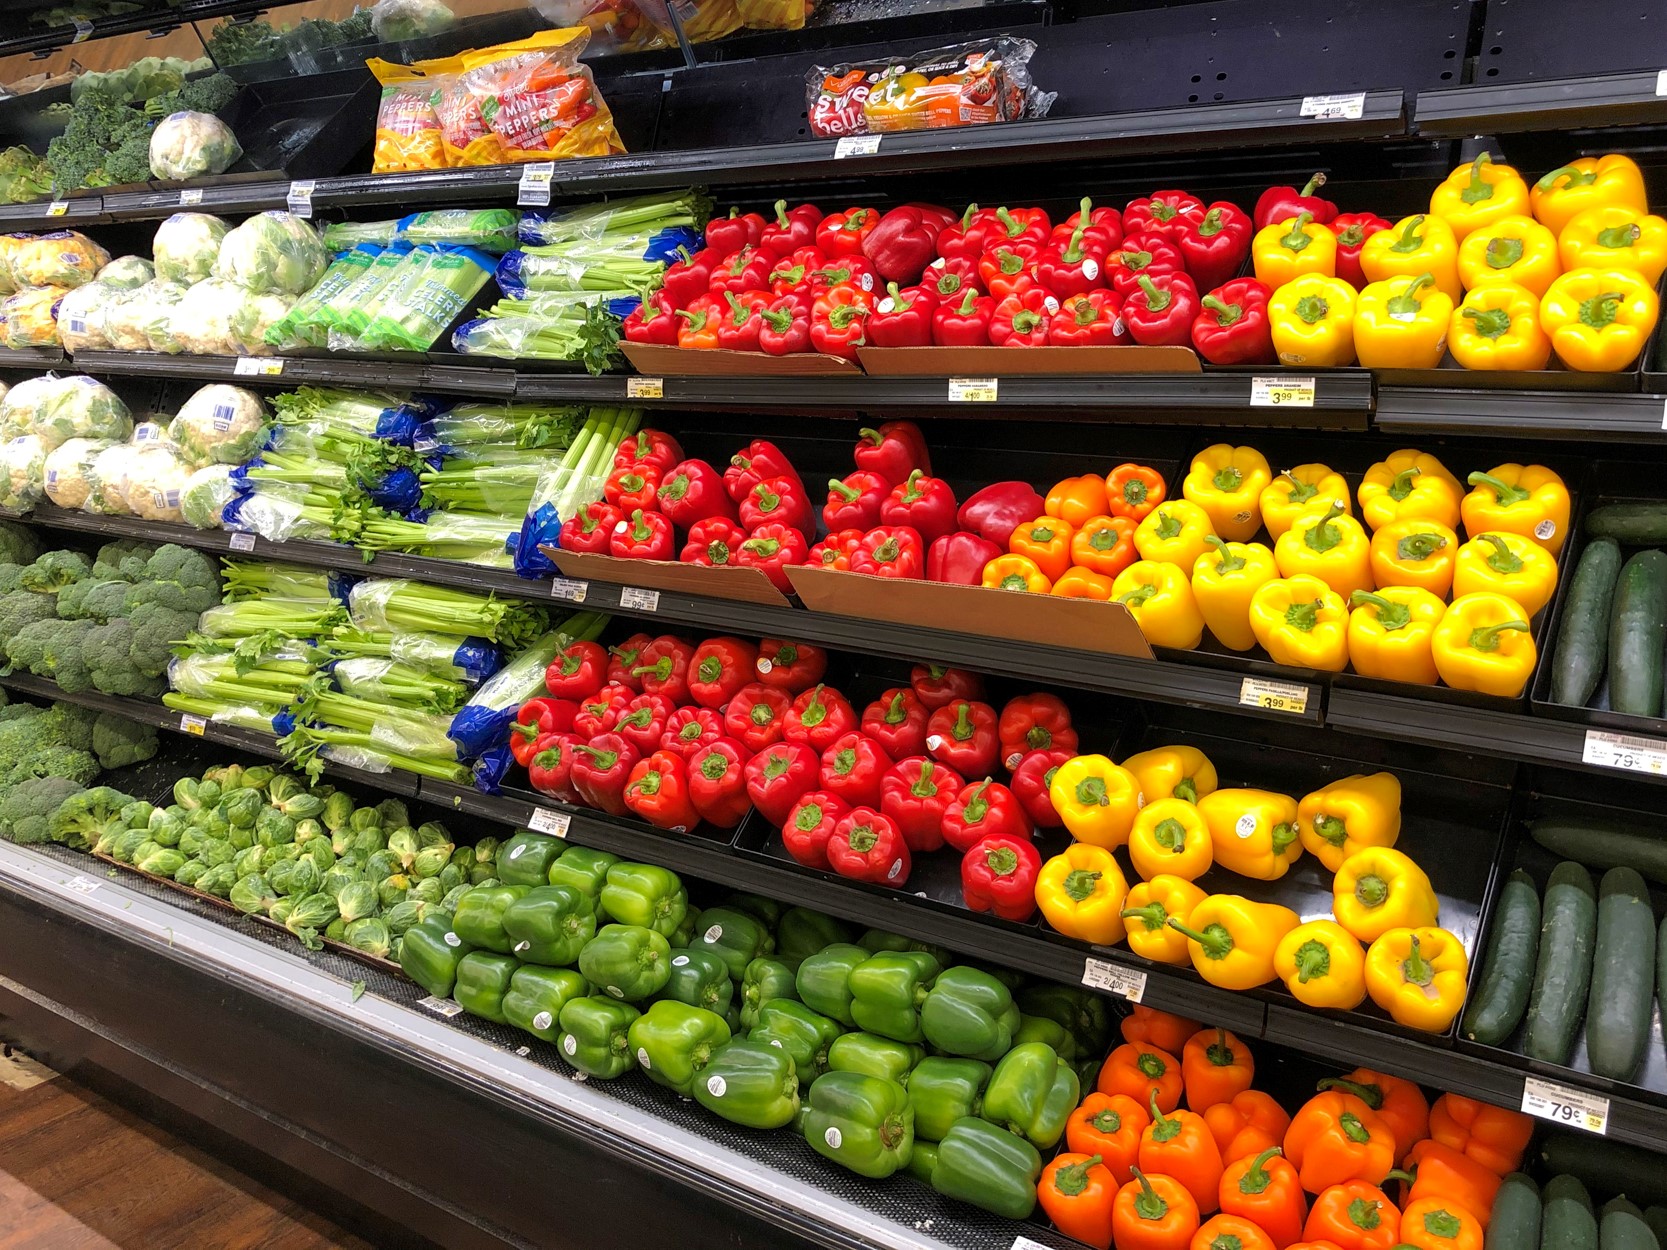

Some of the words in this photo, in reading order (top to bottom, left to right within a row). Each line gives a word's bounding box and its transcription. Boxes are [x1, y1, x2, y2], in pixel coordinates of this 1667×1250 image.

[505, 94, 539, 117] MINI
[815, 80, 899, 113] sweet
[382, 101, 432, 116] PEPPERS
[497, 104, 559, 138] PEPPERS
[403, 297, 452, 329] STALKS
[413, 288, 461, 318] CELERY
[1272, 392, 1292, 404] 399
[1264, 696, 1285, 708] 399
[1550, 1091, 1584, 1104] CUCUMBERS
[1551, 1101, 1581, 1120] 79¢
